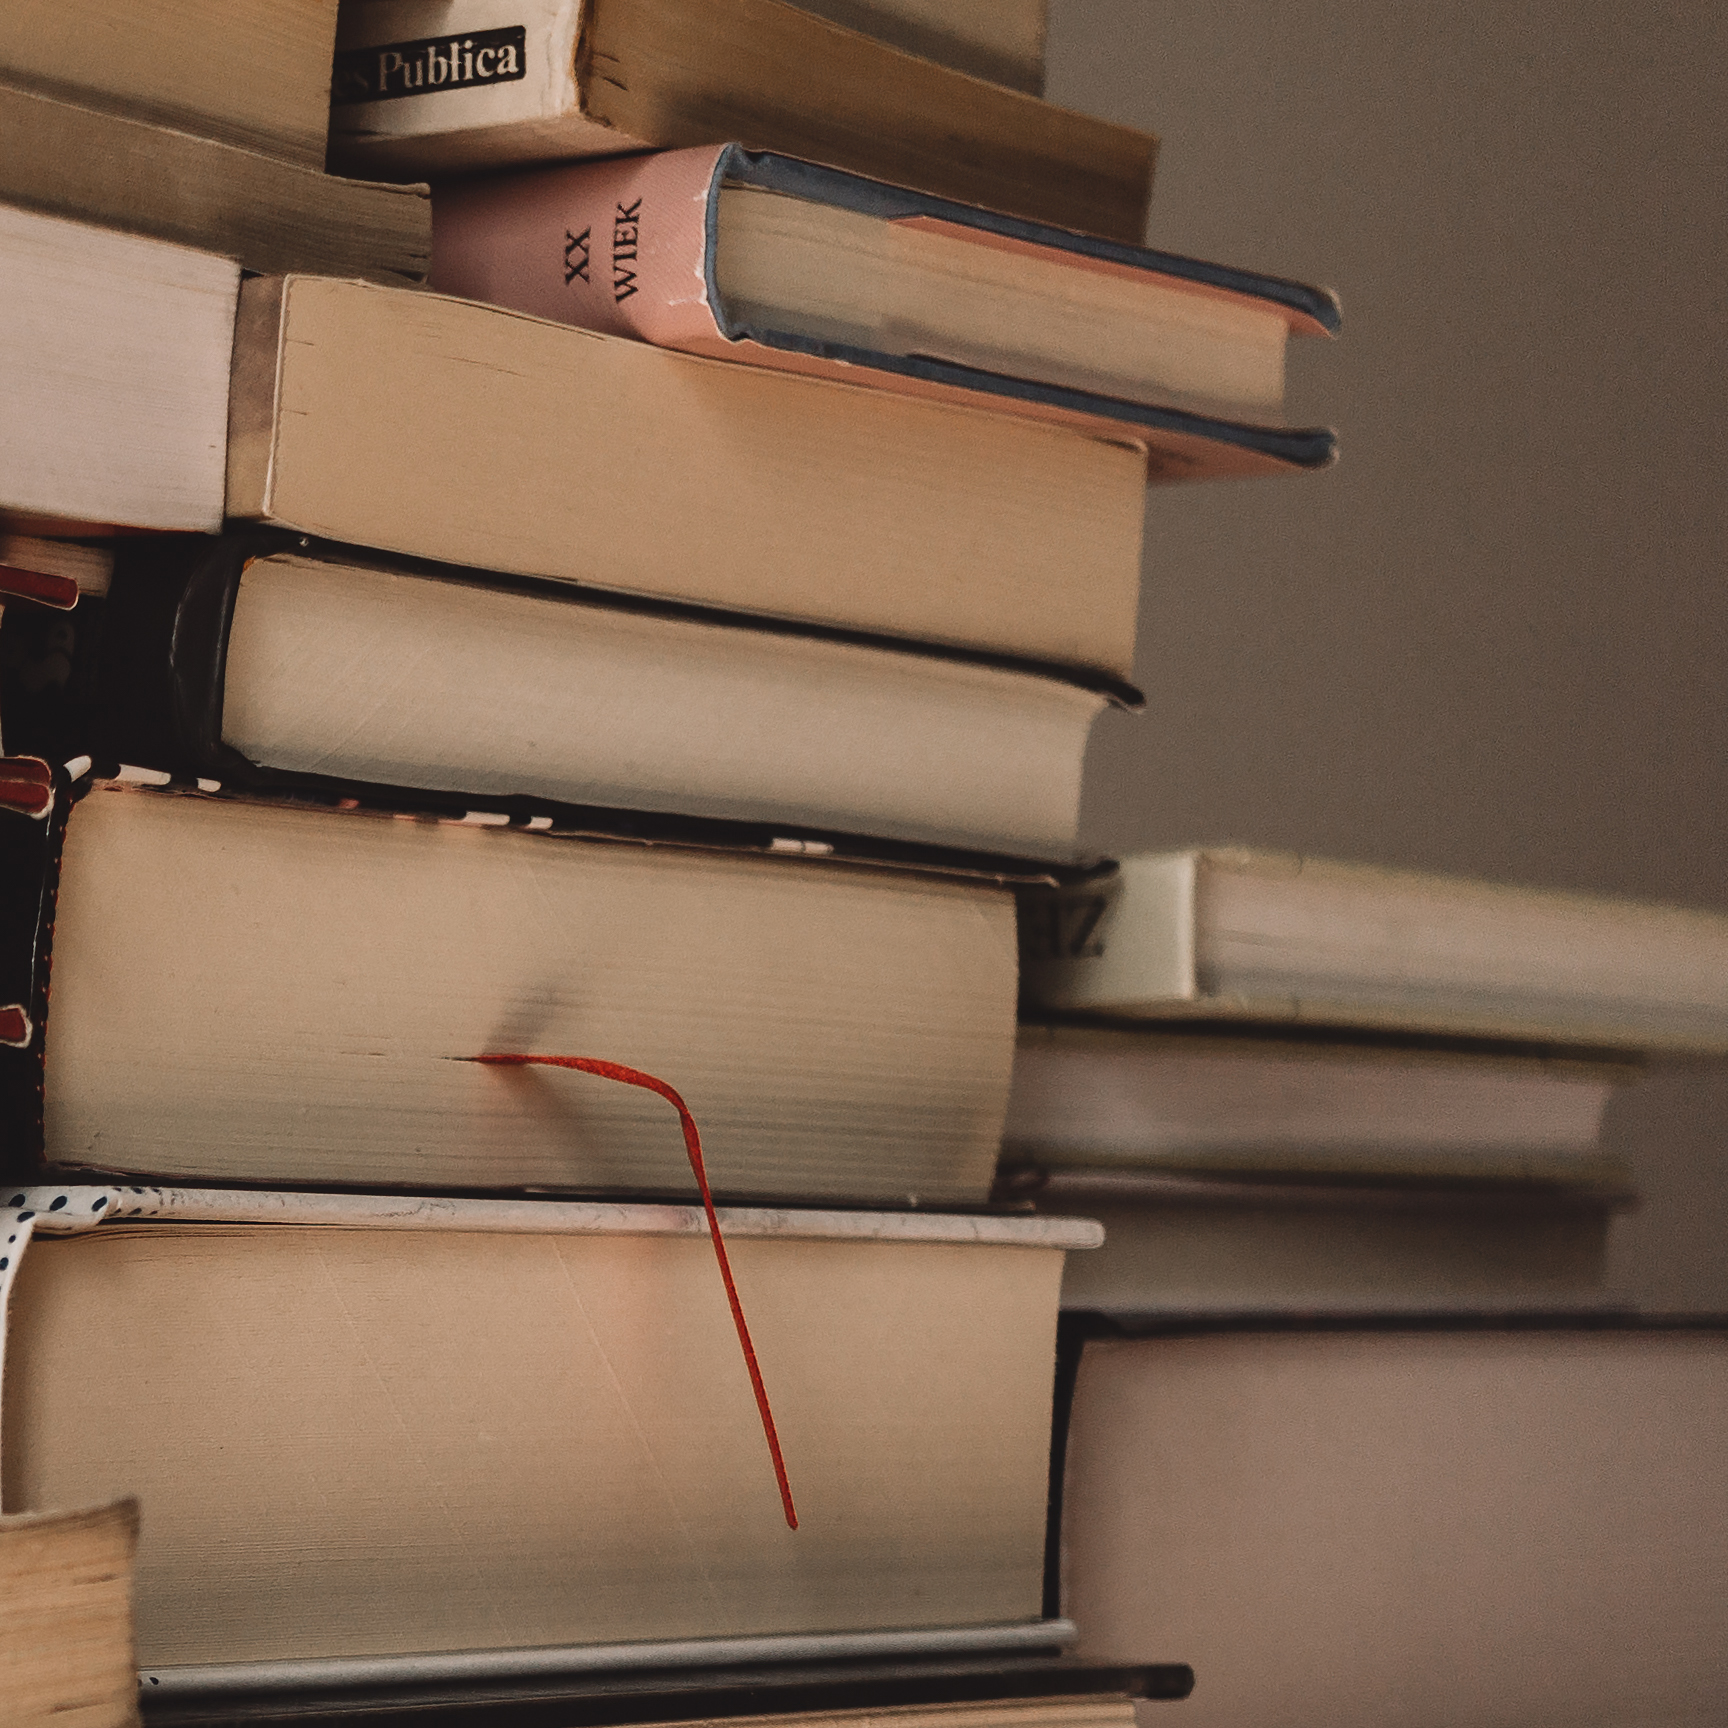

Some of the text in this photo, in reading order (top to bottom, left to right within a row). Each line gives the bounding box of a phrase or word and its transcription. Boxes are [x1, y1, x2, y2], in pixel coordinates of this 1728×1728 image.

[379, 40, 520, 91] Publica
[565, 226, 592, 286] XX
[613, 199, 643, 303] WIEK
